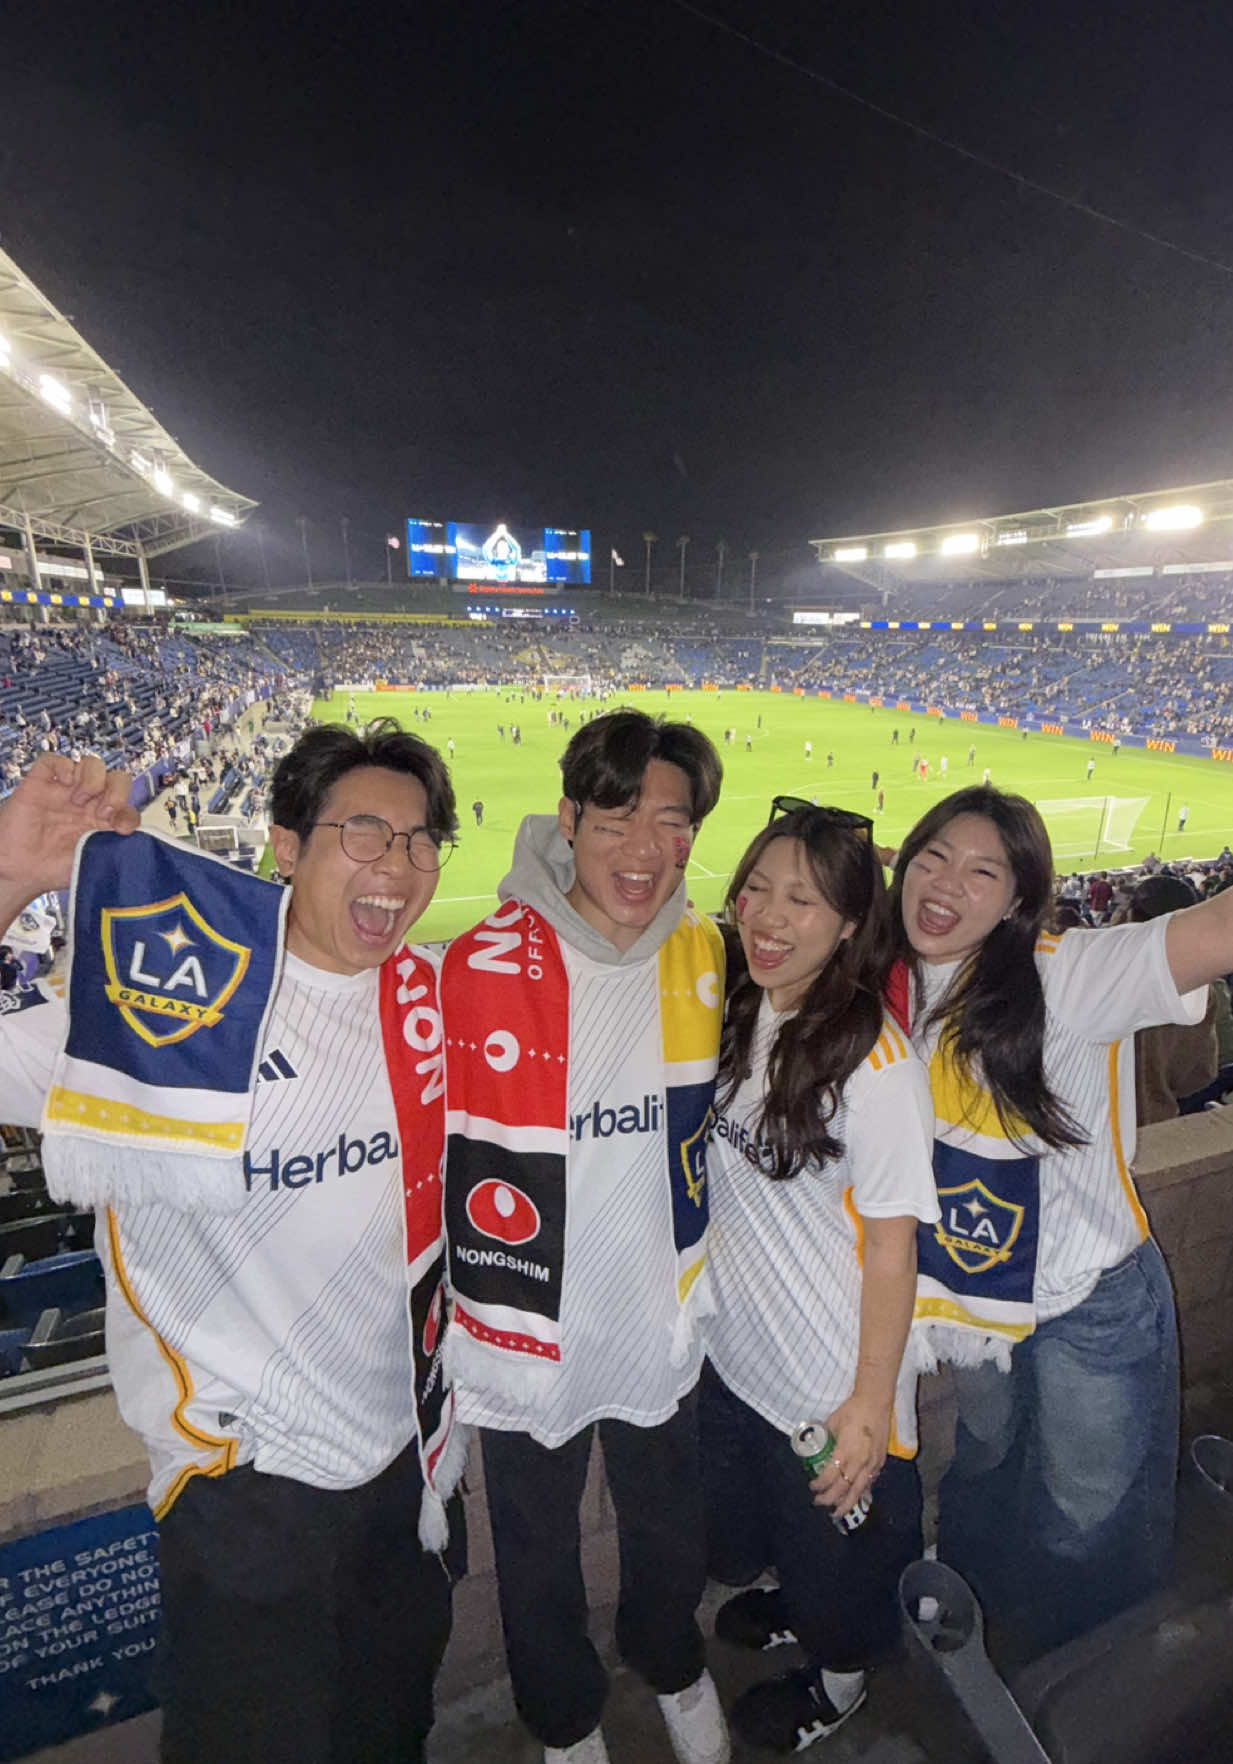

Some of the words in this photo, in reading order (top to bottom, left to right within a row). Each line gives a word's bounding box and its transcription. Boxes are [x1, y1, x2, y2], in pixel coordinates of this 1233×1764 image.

[1151, 623, 1171, 632] WIN
[1208, 623, 1230, 634] WIN
[1041, 724, 1063, 736] WIN
[1090, 730, 1115, 744] WIN
[1146, 739, 1175, 753] WIN
[1211, 748, 1233, 762] WI
[130, 941, 208, 998] LA
[119, 990, 207, 1018] GALAXY
[570, 1094, 664, 1141] rbali
[243, 1131, 398, 1192] Herba
[950, 1207, 999, 1244] LA
[456, 1245, 550, 1282] NONGSHIM
[16, 1560, 66, 1582] THE
[0, 1592, 69, 1623] EASE
[79, 1578, 112, 1597] DO
[34, 1629, 98, 1659] YOUR
[40, 1620, 82, 1643] THE
[25, 1657, 104, 1690] THANK
[112, 1637, 156, 1660] YOU
